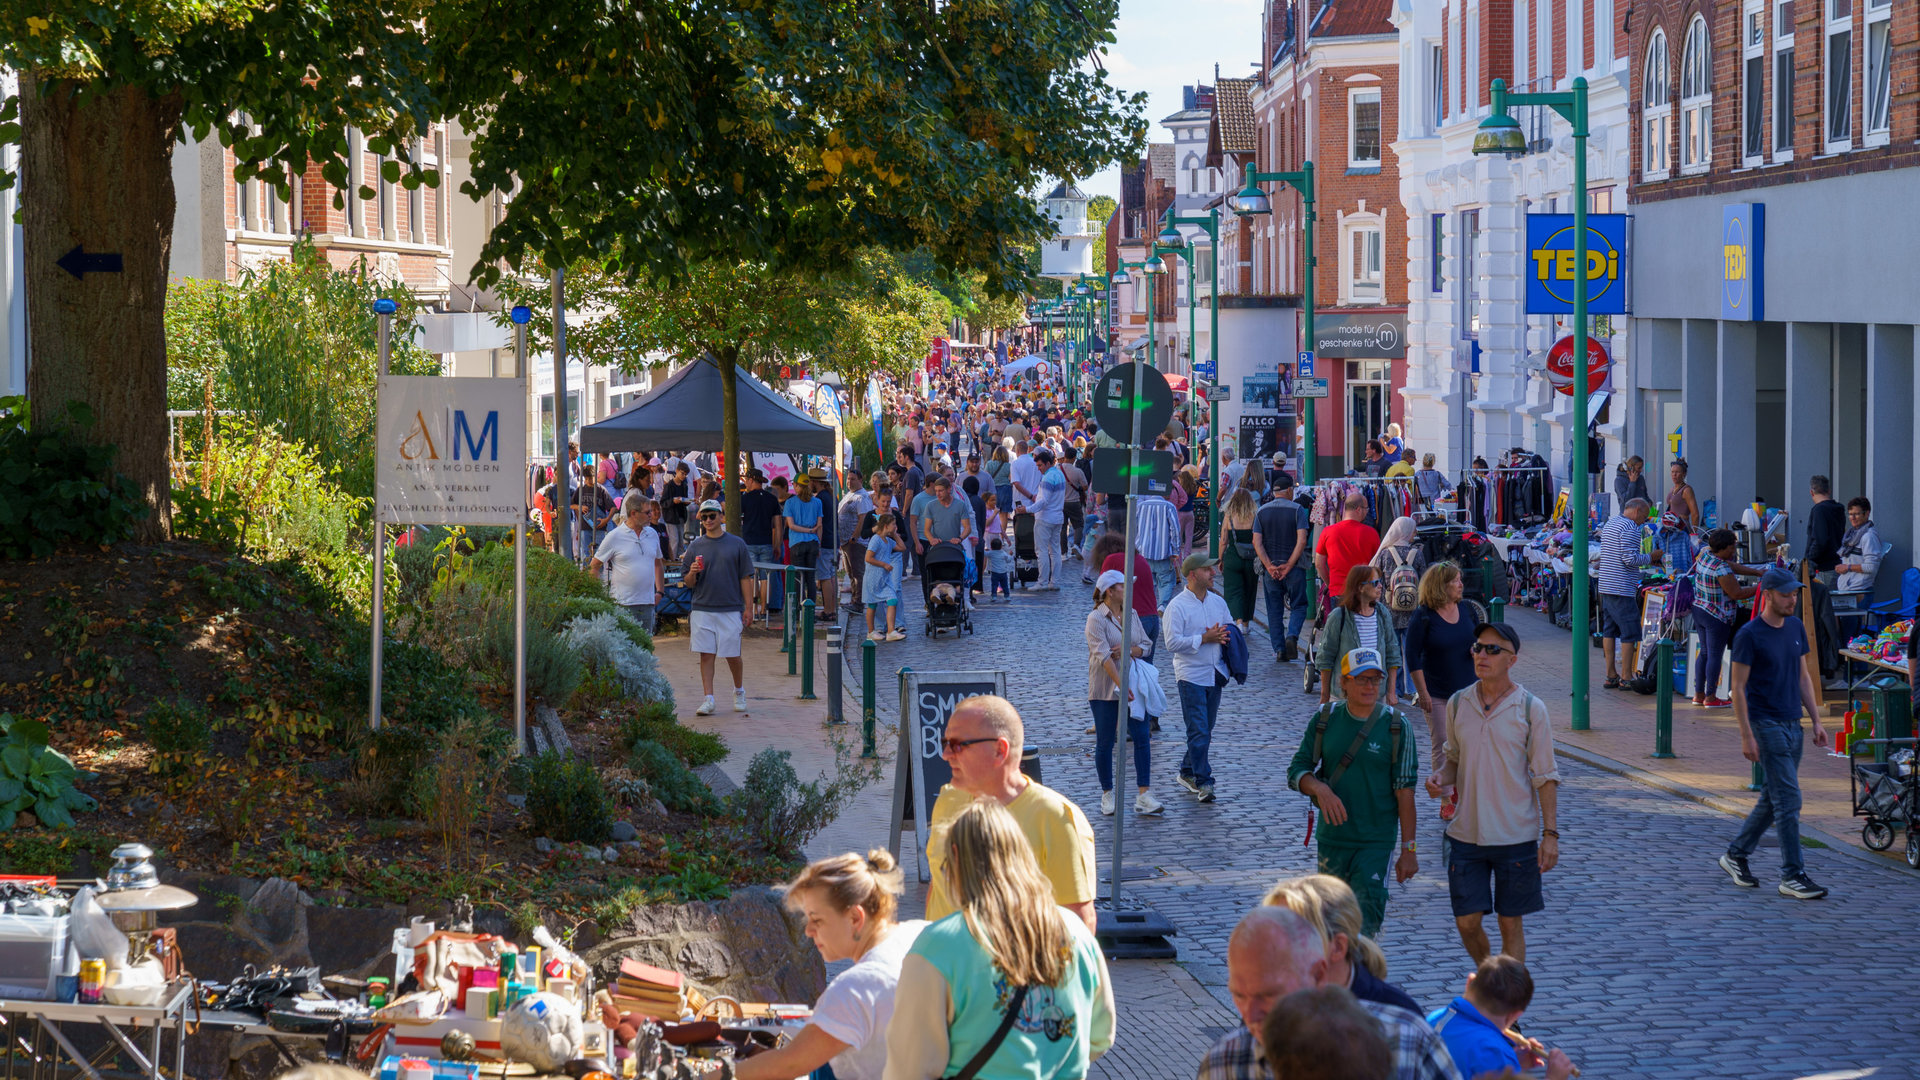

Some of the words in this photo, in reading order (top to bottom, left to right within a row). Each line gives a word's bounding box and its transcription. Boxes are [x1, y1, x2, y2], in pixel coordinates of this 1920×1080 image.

[1532, 249, 1619, 280] TEDi
[1724, 244, 1747, 280] TEDi
[1338, 325, 1362, 334] mode
[1364, 324, 1375, 334] für
[1380, 330, 1393, 342] m
[1319, 339, 1362, 349] geschenke
[1364, 338, 1375, 348] für
[1241, 417, 1275, 425] FALCO
[396, 463, 436, 472] ANTIK
[443, 464, 500, 473] MODERN
[444, 484, 491, 492] VERKAUF
[448, 494, 454, 502] &
[383, 504, 519, 513] HAUSHALTSAUFLÖSUNGEN
